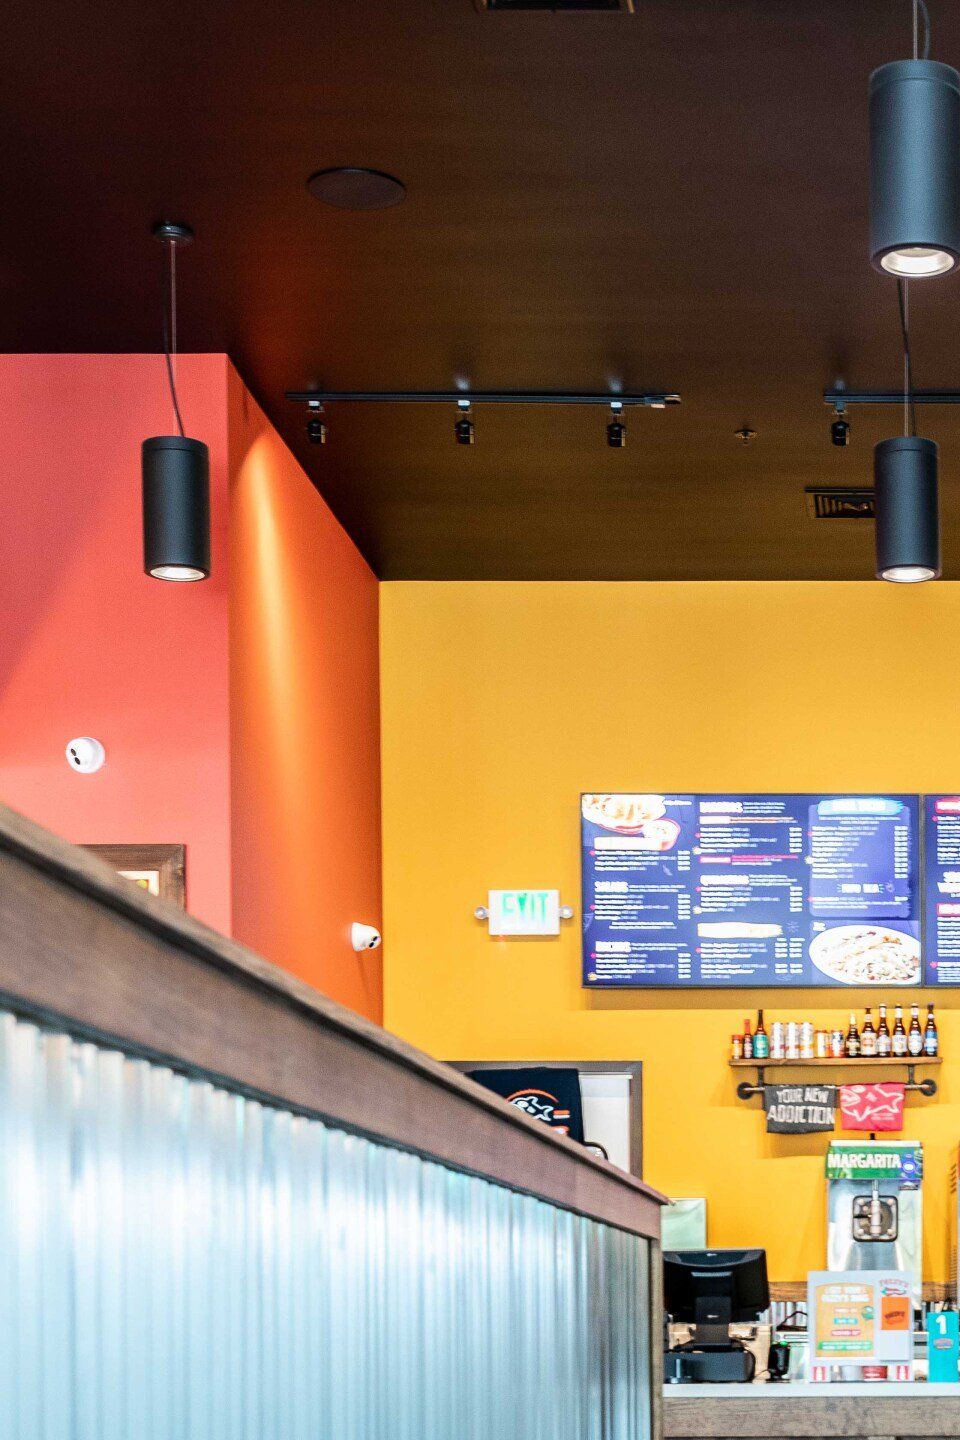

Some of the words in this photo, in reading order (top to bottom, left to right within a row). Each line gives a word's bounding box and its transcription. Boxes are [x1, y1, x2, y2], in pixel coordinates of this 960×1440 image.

[502, 892, 549, 921] EXIT
[776, 1088, 803, 1103] YOUR
[804, 1087, 829, 1103] NEW
[766, 1105, 836, 1125] ADDICTION
[827, 1153, 902, 1169] MARGARITA
[935, 1314, 948, 1335] 1
